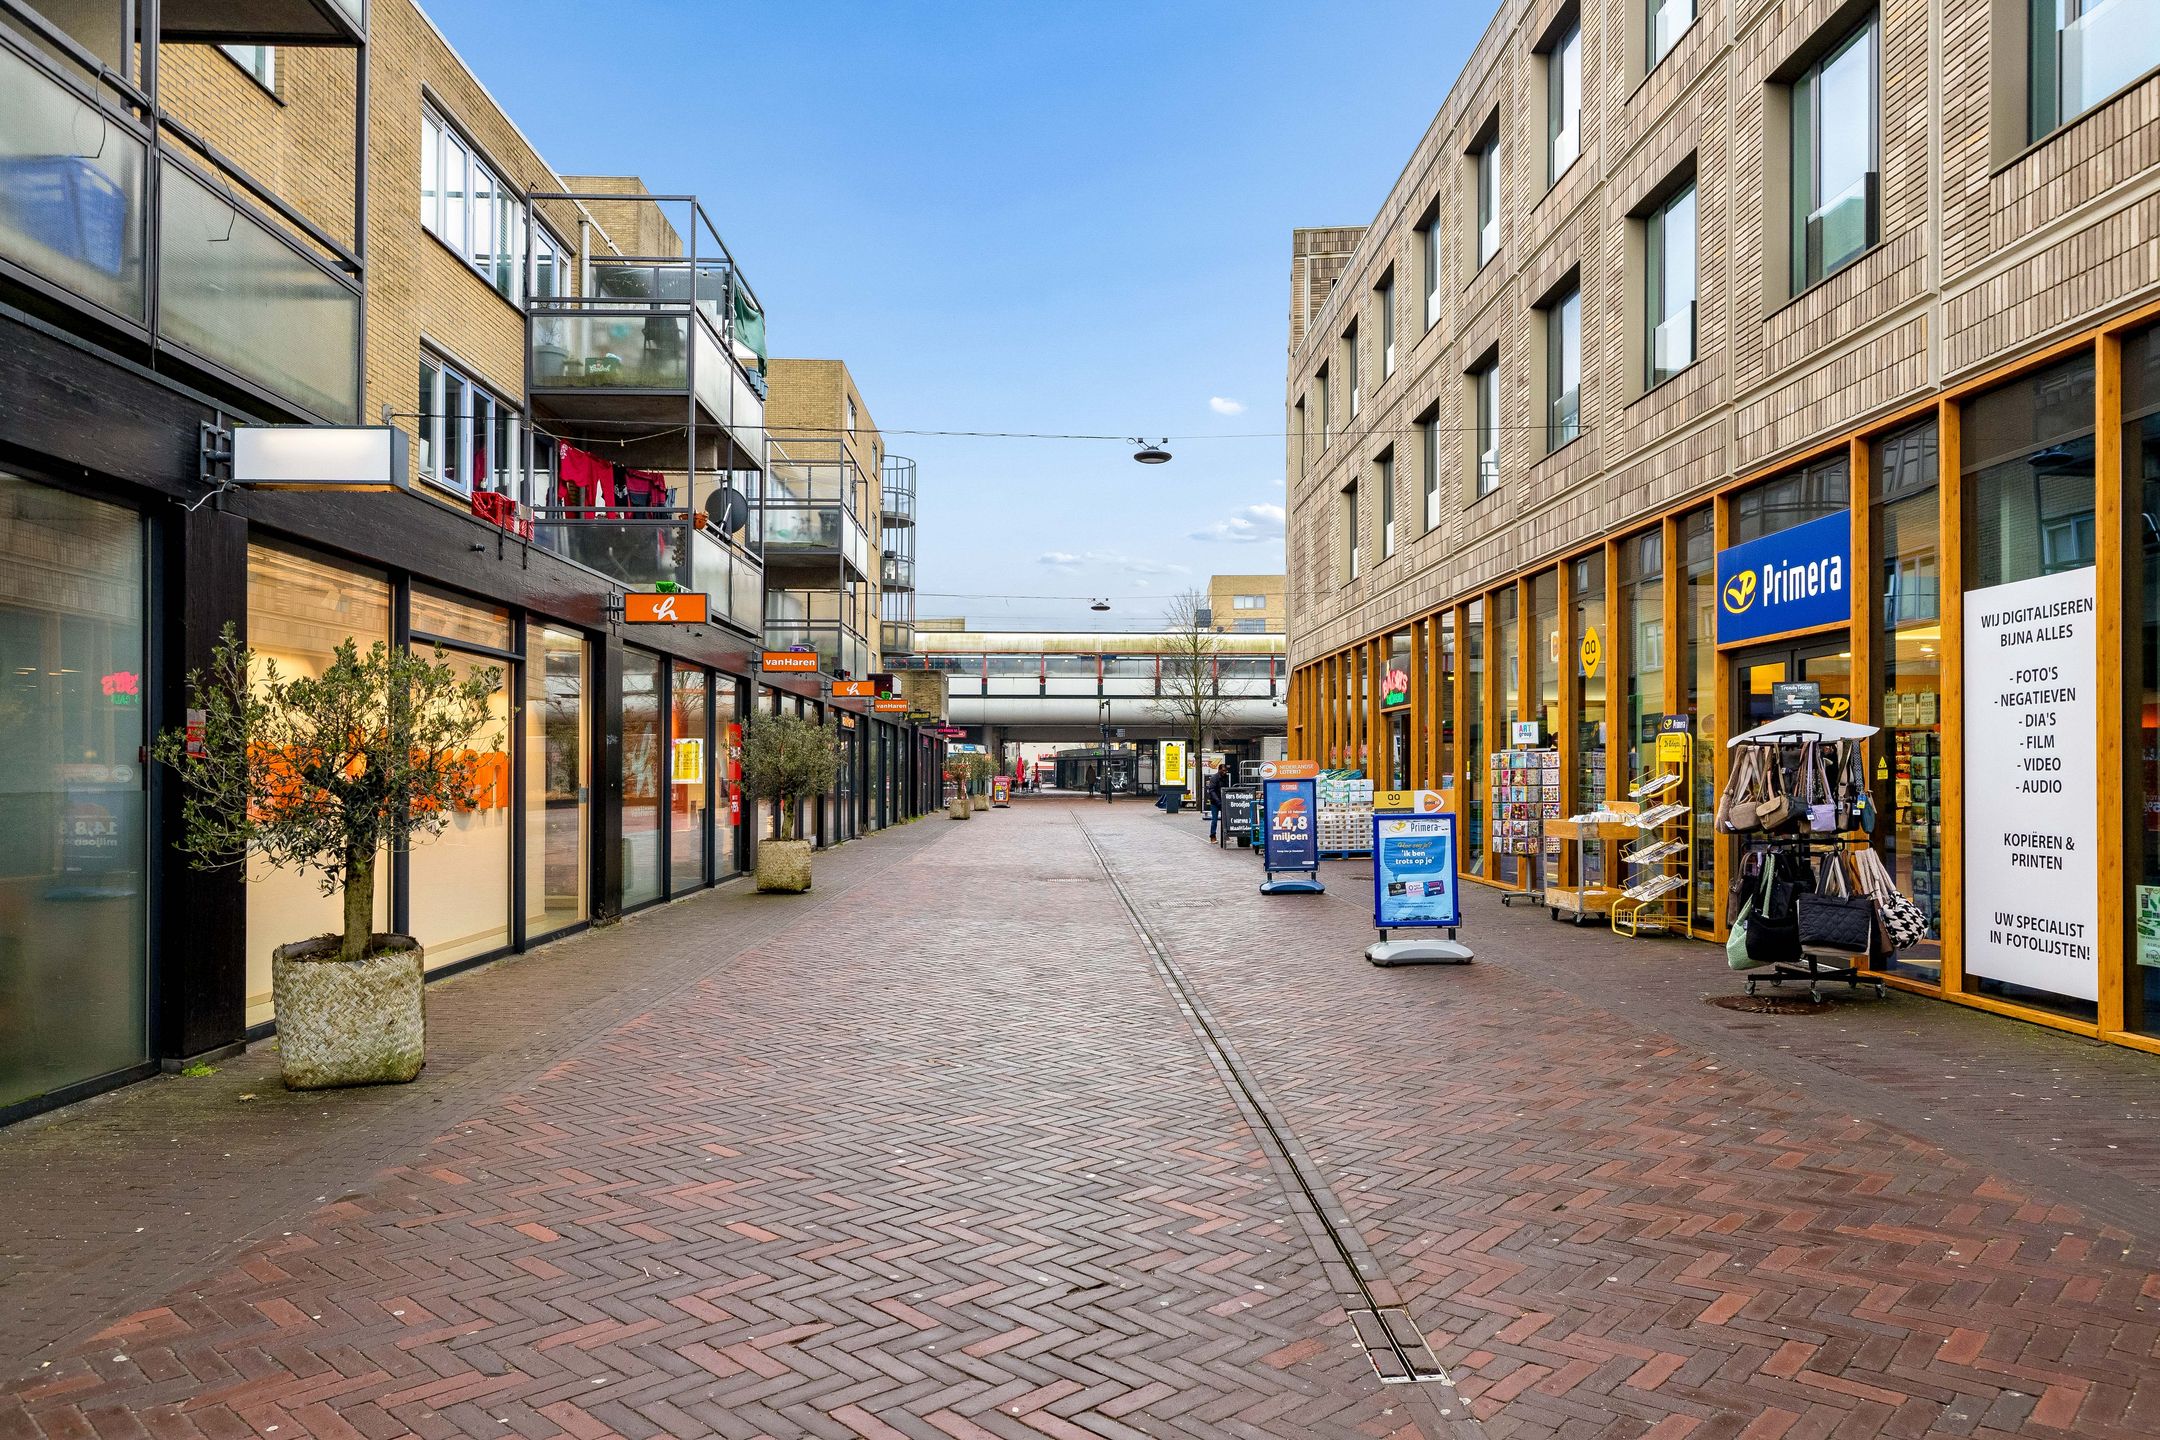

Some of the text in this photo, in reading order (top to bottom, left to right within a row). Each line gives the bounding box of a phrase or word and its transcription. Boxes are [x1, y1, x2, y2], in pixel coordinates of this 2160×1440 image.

[1763, 555, 1842, 607] Primera
[652, 596, 679, 621] h
[1981, 597, 2093, 629] WIJ DIGITALISEREN
[2000, 624, 2073, 648] BIJNA ALLES
[765, 658, 816, 666] vanHaren
[2016, 666, 2059, 684] FOTO'S
[2000, 687, 2076, 707] NEGATIEVEN
[2025, 712, 2057, 728] DIA'S
[2026, 735, 2055, 749] FILM
[2023, 757, 2062, 772] VIDEO
[2022, 779, 2062, 794] AUDIO
[1272, 815, 1308, 832] 14,8
[1410, 823, 1440, 832] Primera
[1272, 832, 1309, 843] miljoen
[2004, 830, 2075, 851] KOPIËREN &
[2011, 853, 2063, 871] PRINTEN
[1994, 912, 2085, 939] UW SPECIALIST
[1990, 930, 2090, 961] IN FOTOLIJSTEN!
